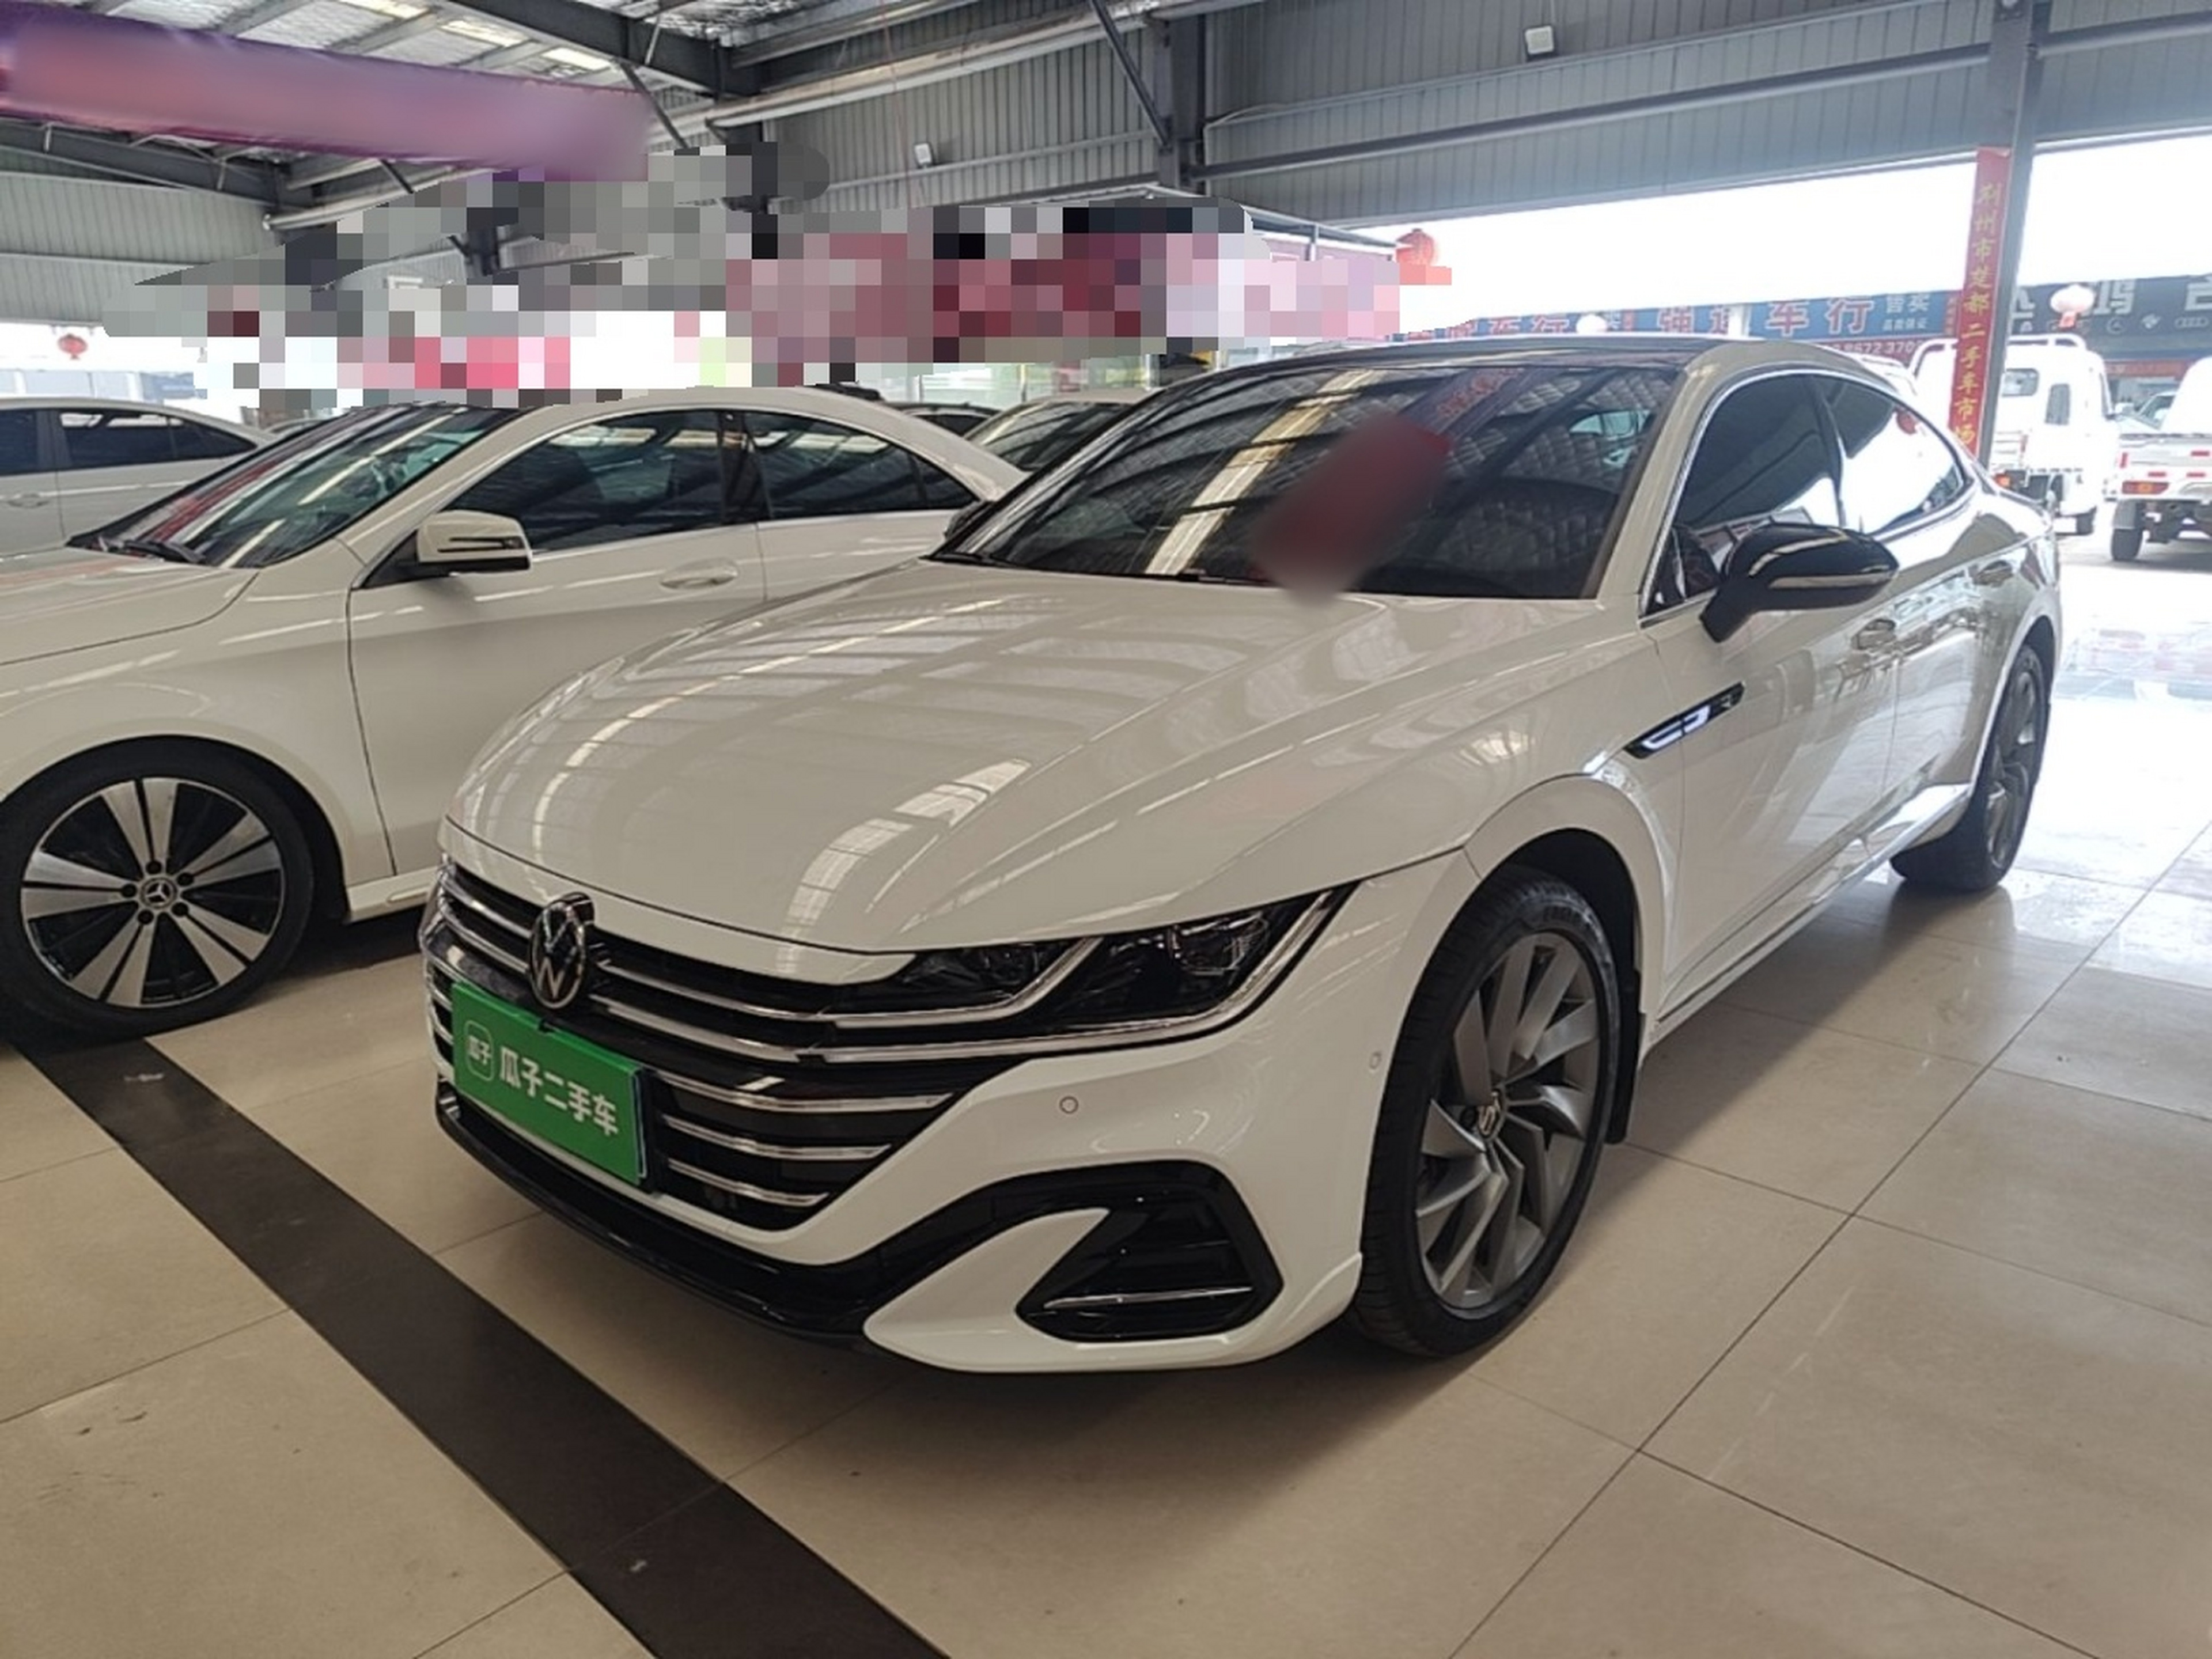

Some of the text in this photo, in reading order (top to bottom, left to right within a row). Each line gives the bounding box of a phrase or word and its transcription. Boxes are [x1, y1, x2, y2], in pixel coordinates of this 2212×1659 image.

[499, 1046, 619, 1136] 瓜子二手车
